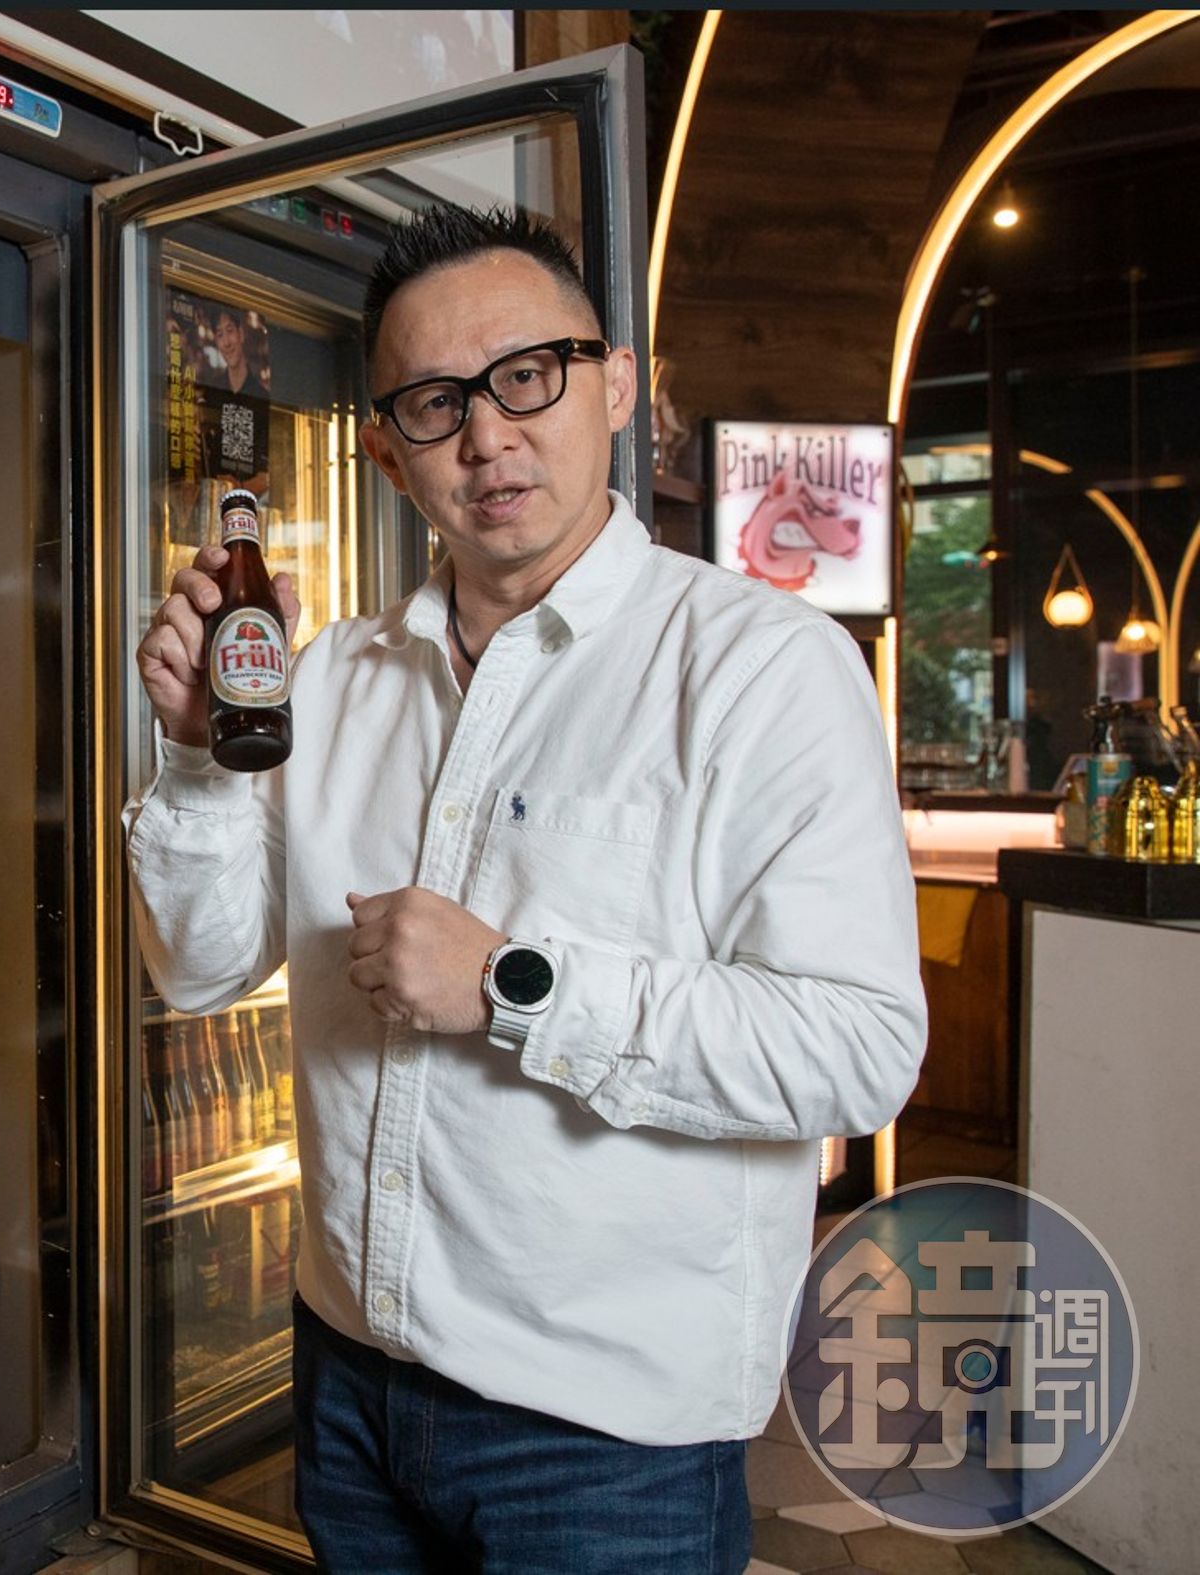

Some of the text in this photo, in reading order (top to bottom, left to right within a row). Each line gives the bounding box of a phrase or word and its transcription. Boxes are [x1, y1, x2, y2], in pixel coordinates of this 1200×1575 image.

[720, 435, 882, 505] Pink Killer
[219, 643, 284, 675] Früli
